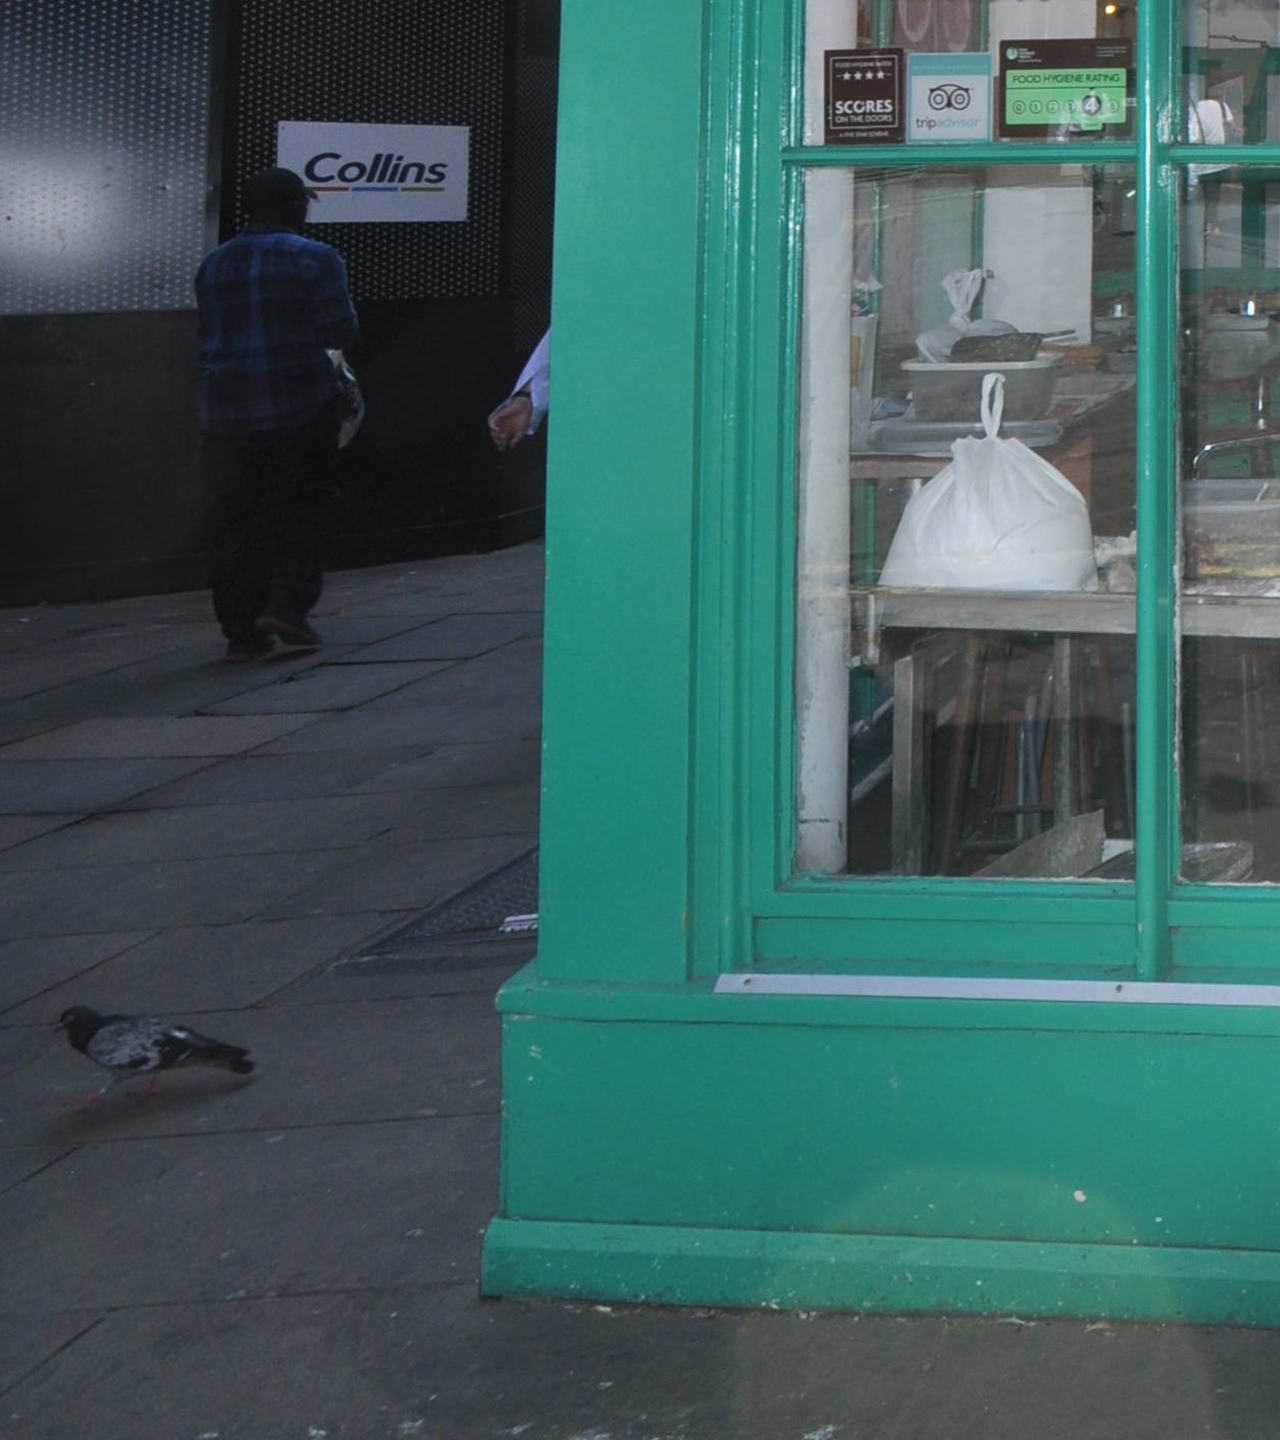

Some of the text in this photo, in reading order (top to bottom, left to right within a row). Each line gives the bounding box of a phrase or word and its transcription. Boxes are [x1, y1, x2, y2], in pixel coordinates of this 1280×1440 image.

[1012, 73, 1120, 83] FOOD HYGIENE RATING
[835, 100, 893, 114] SCORES
[865, 114, 893, 123] DOORS
[304, 152, 448, 184] Collins
